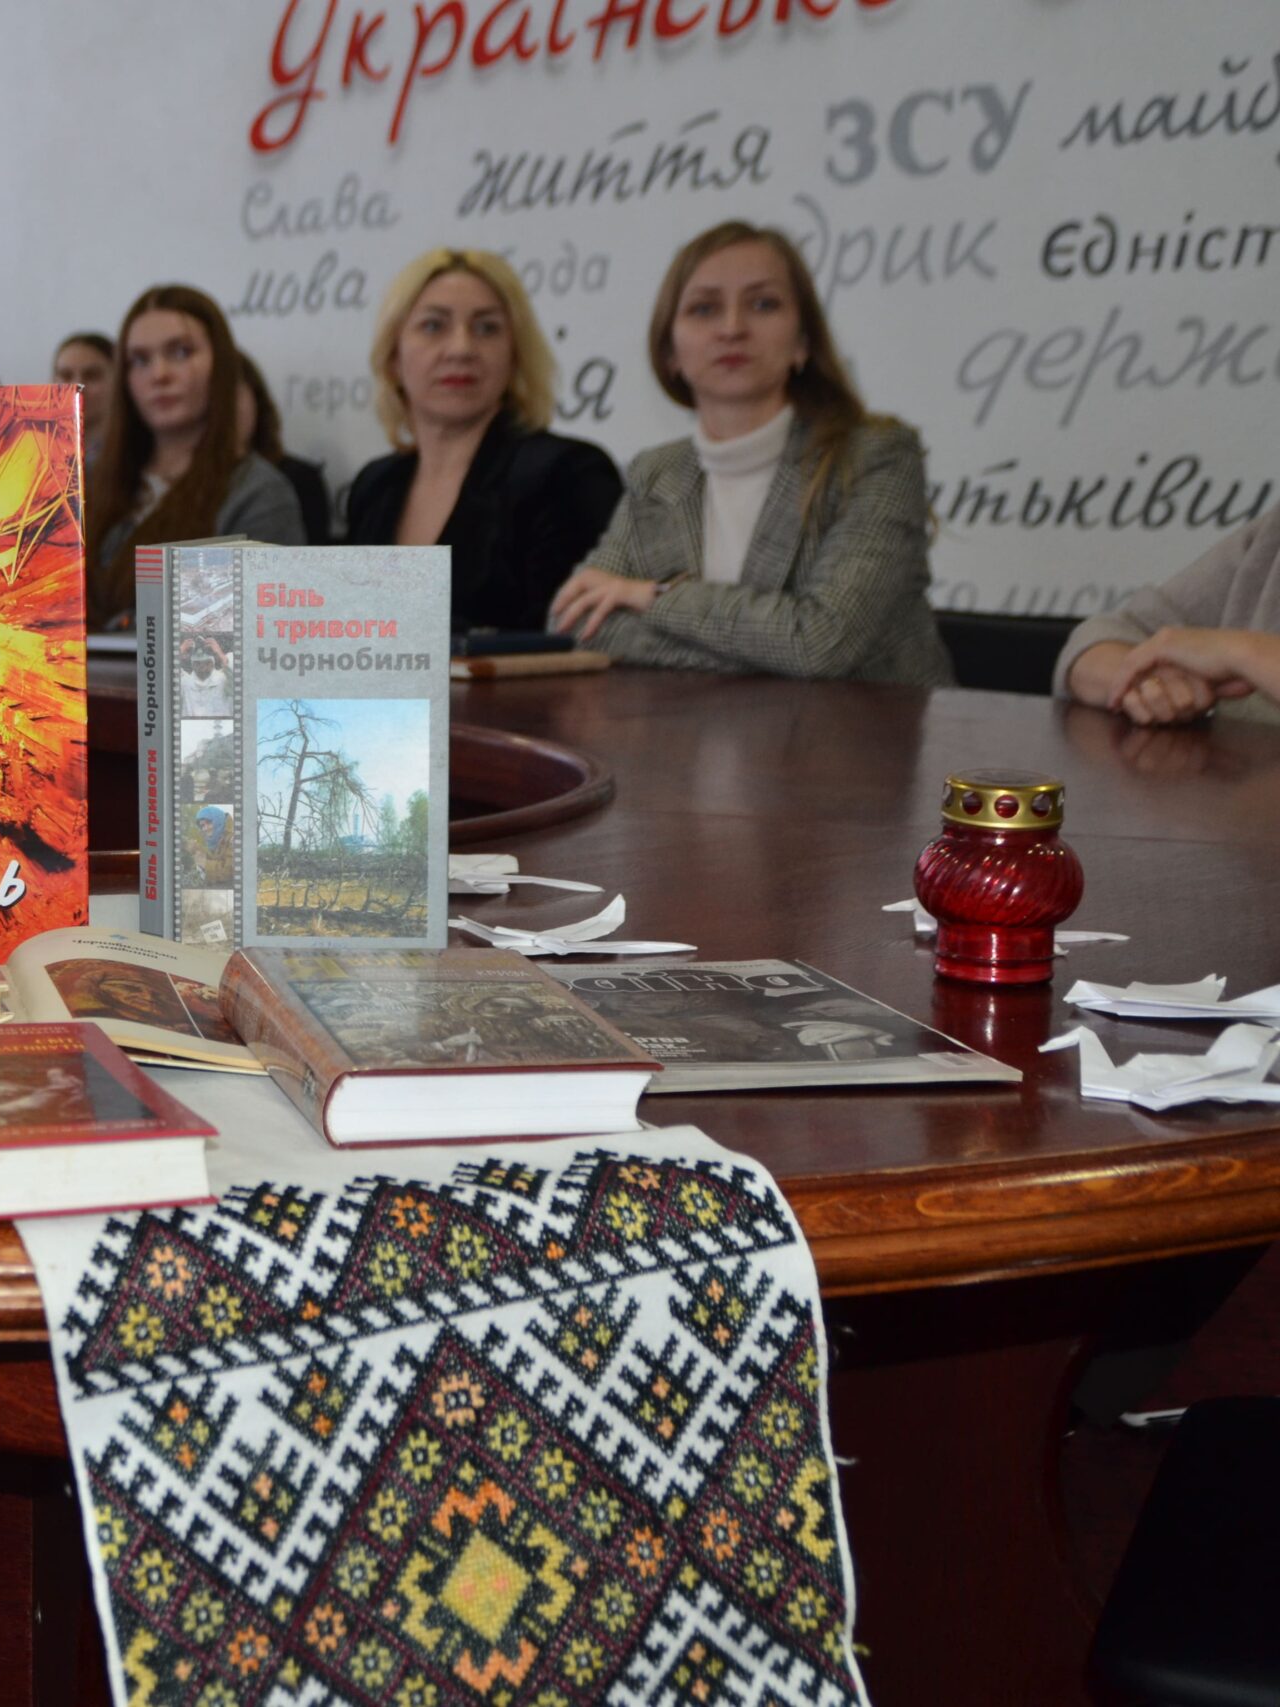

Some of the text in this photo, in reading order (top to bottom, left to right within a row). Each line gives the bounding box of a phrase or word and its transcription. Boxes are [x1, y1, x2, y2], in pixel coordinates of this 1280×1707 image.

[457, 110, 772, 218] життя
[824, 79, 1032, 188] ЗСУ
[240, 172, 401, 241] Слава
[229, 248, 368, 318] мова
[793, 192, 999, 311] дрик
[956, 307, 1280, 430] держ
[256, 582, 325, 608] Біль
[256, 615, 398, 644] і тривоги
[142, 615, 158, 737] Чорнобиля
[257, 646, 431, 677] Чорнобиля
[144, 749, 160, 836] тривоги
[145, 850, 158, 900] Біль
